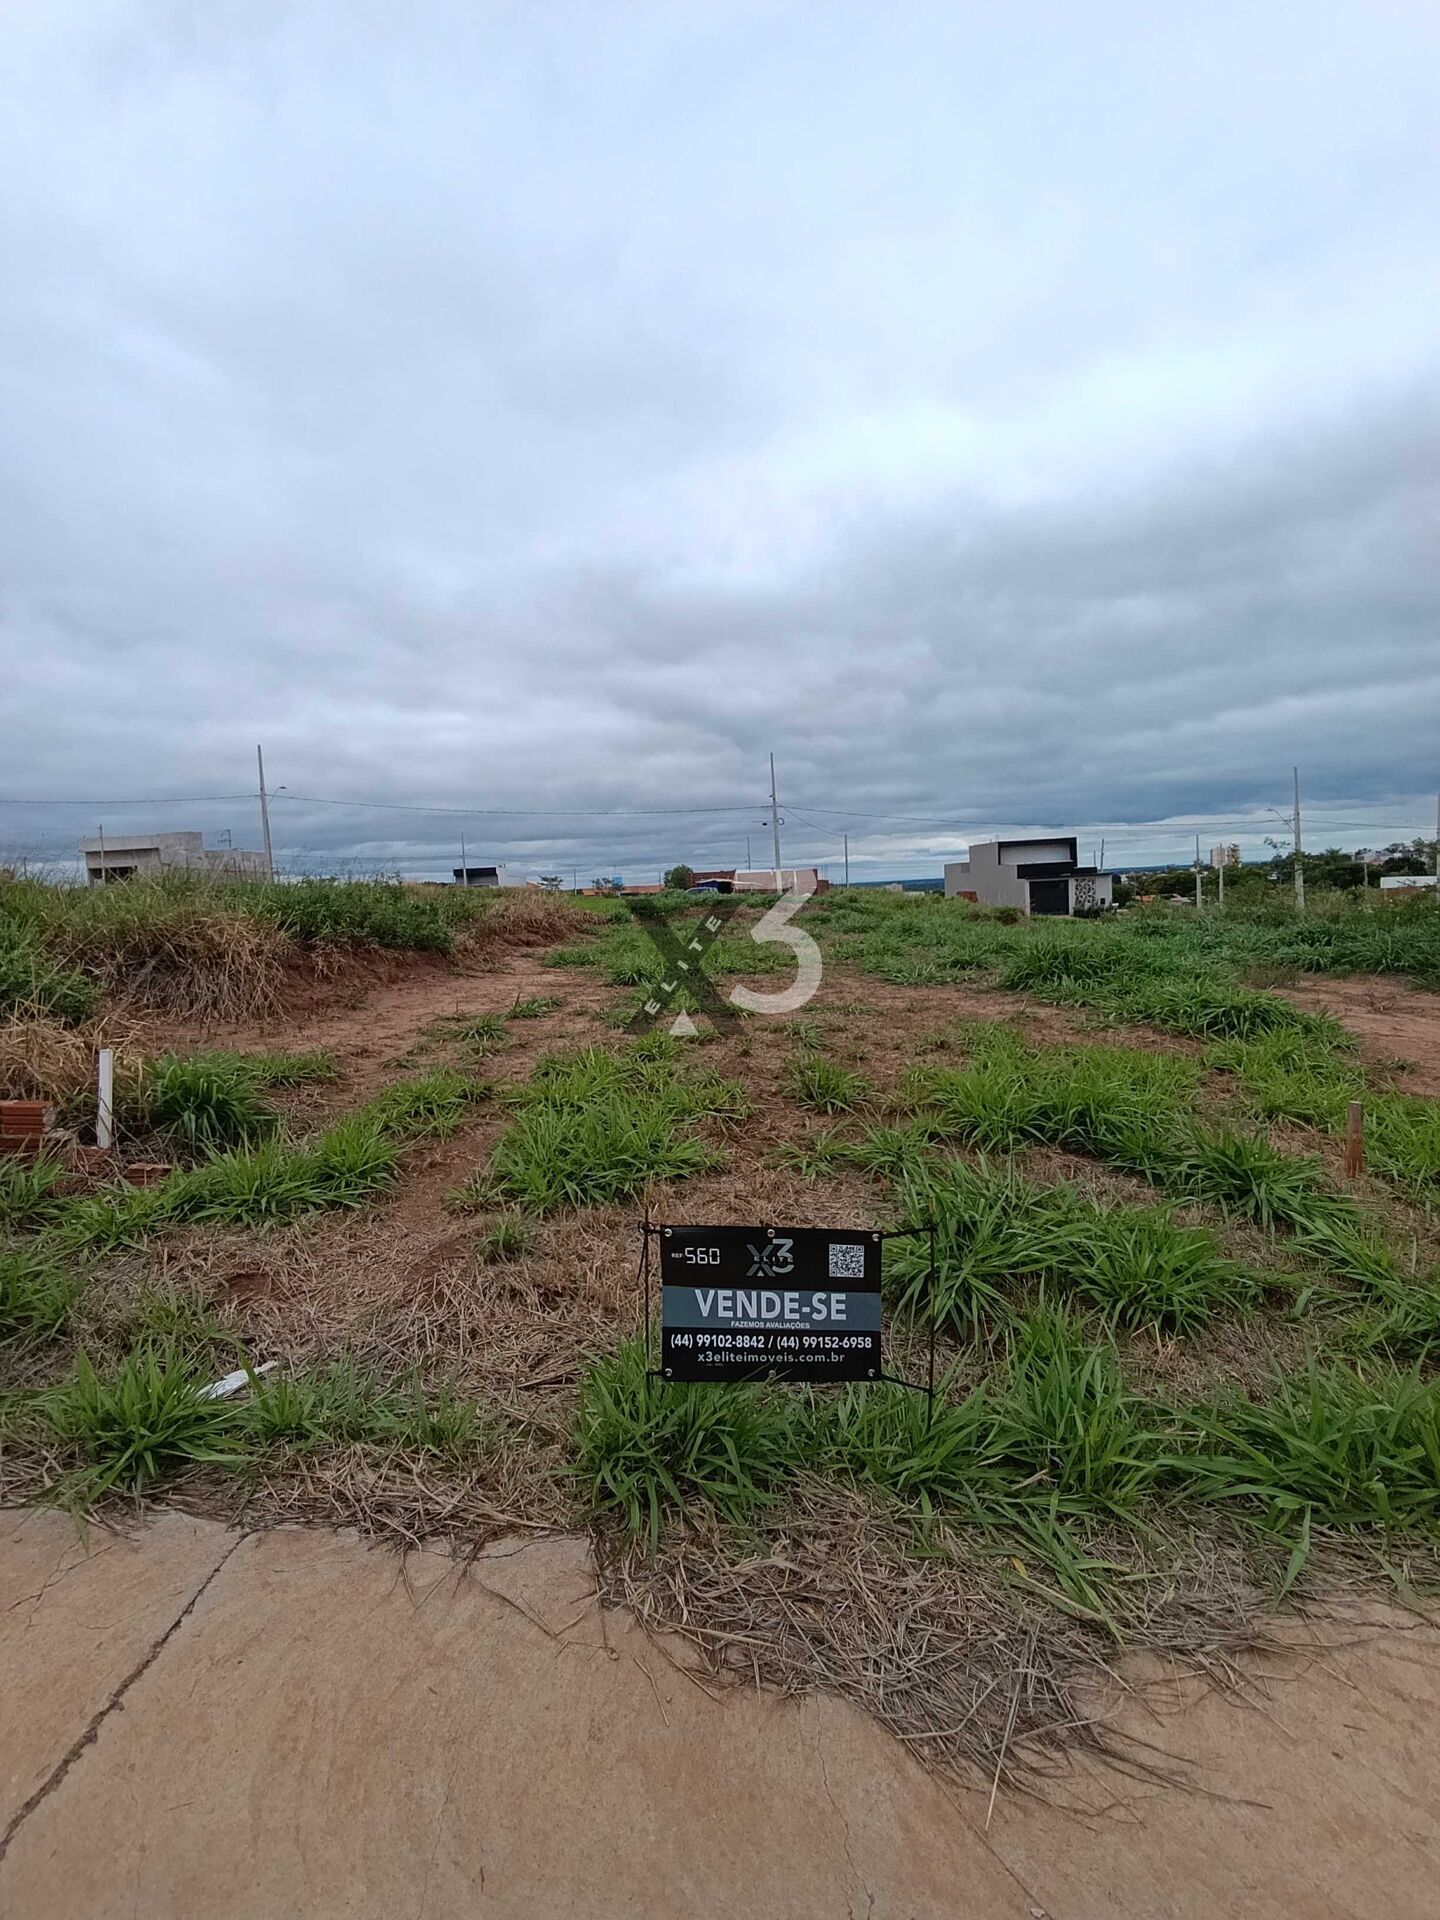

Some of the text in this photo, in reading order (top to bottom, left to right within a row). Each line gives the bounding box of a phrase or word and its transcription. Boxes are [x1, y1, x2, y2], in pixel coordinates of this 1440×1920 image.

[684, 1247, 720, 1264] 560
[695, 1289, 847, 1321] VENDE-SE
[730, 1320, 810, 1330] FAZEMOS AVALIAÇÕES
[671, 1333, 872, 1350] (44) 99102-8842 / (44) 99152-6958
[697, 1351, 845, 1362] x3eliteimoveis.com.br
